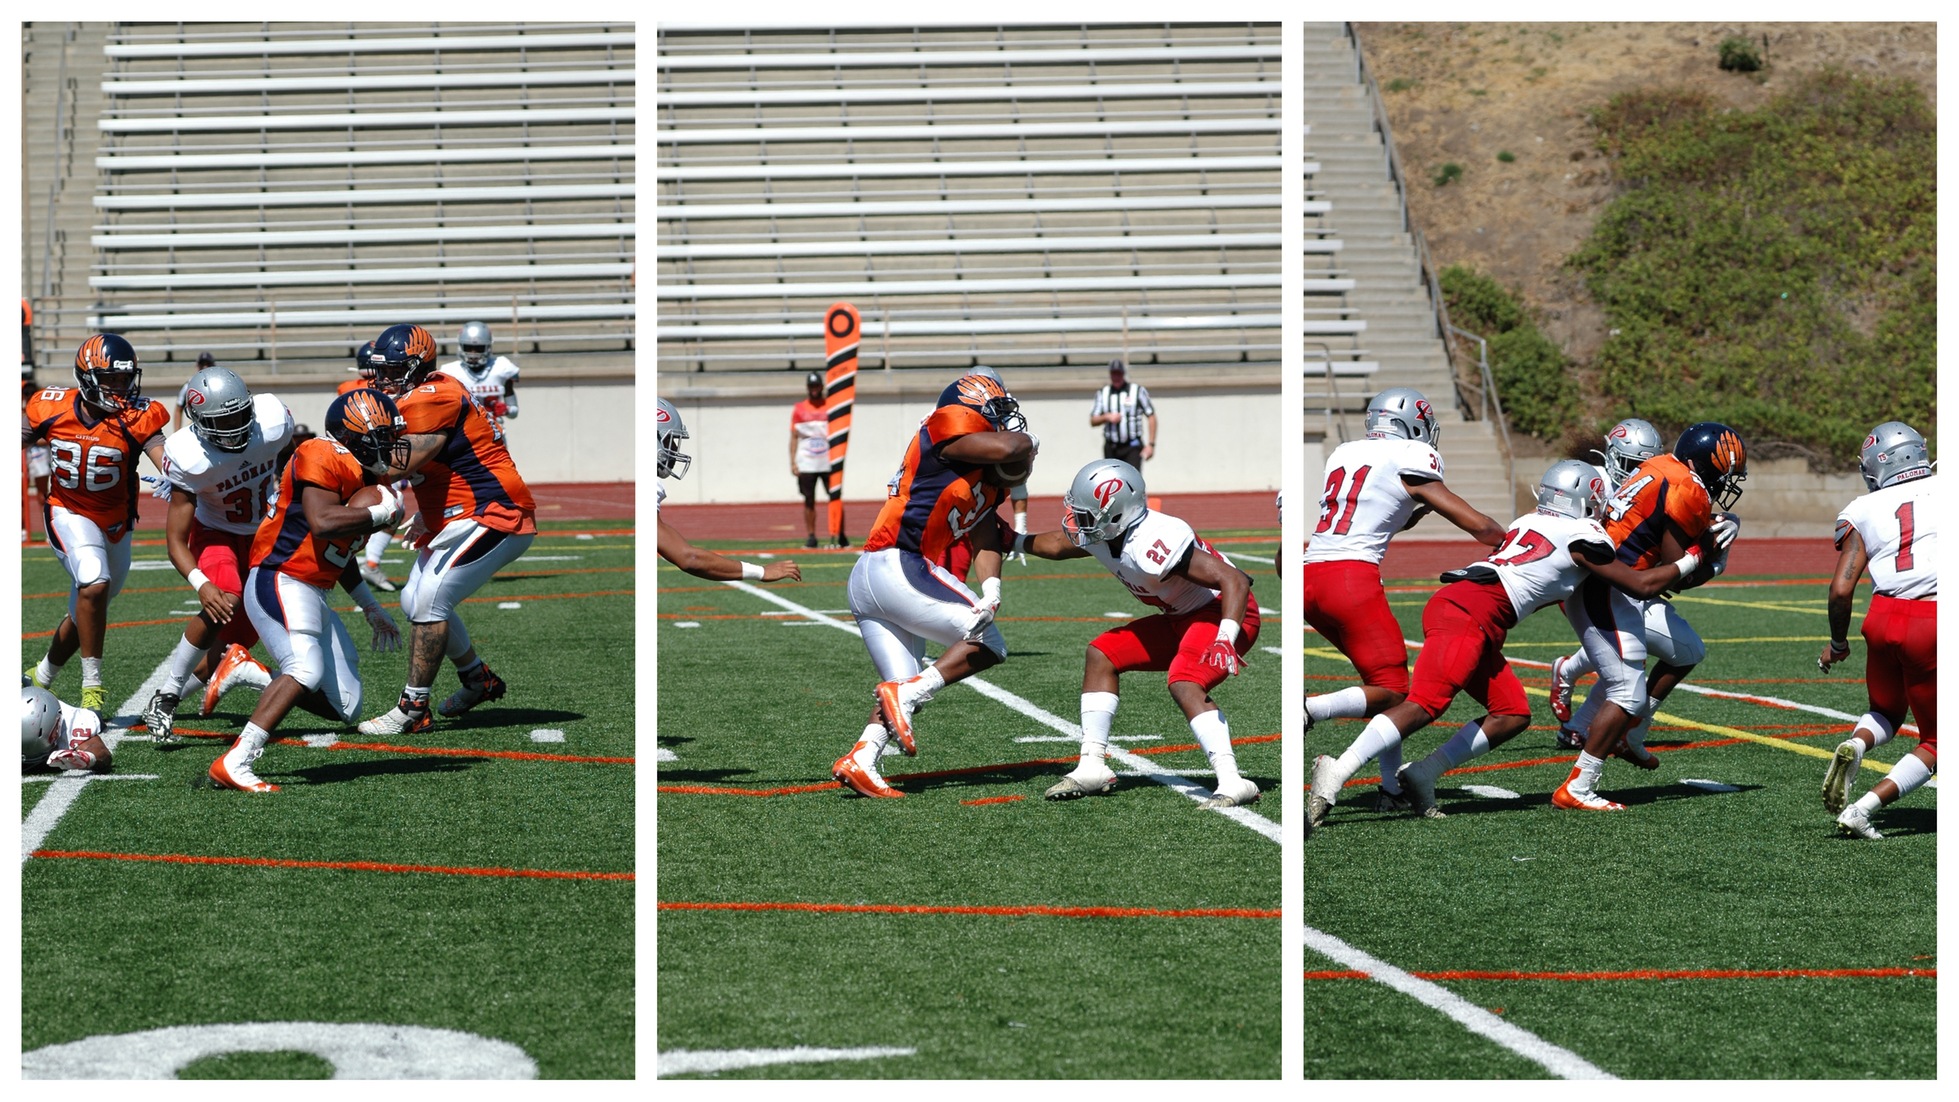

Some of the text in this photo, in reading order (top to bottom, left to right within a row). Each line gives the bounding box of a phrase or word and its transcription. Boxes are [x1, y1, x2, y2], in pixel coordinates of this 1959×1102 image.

[470, 385, 499, 394] LOMAR
[50, 438, 124, 492] 86
[1896, 469, 1926, 481] PALOMAR
[222, 475, 272, 524] 31
[1093, 478, 1124, 509] P
[1314, 464, 1372, 536] 31
[1145, 538, 1172, 566] 27
[1894, 500, 1914, 573] 1
